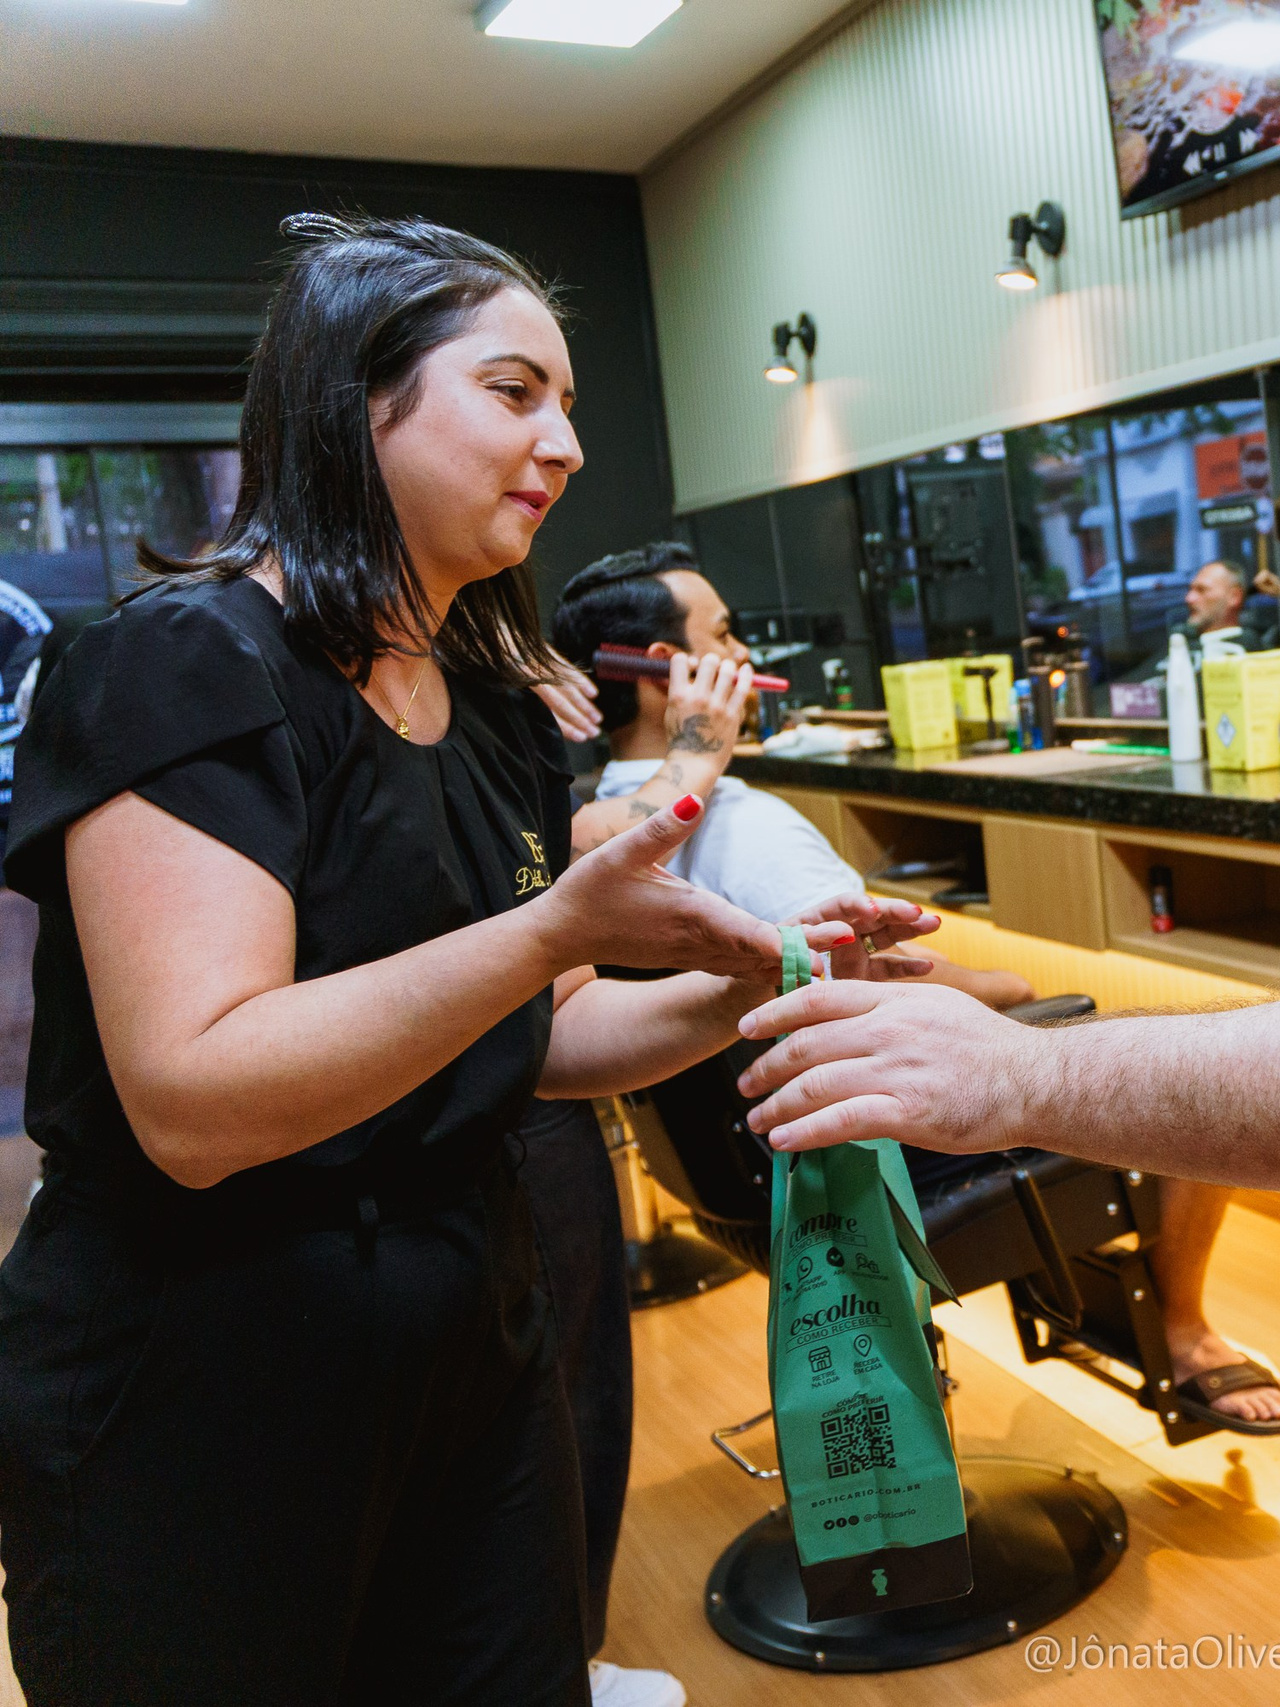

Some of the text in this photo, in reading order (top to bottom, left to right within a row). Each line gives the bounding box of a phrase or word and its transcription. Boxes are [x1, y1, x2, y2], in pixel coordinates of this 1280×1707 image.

[789, 1212, 858, 1249] compre
[790, 1293, 882, 1336] escolha
[797, 1316, 879, 1345] COMO RECEBER
[811, 1370, 837, 1382] RETIRE
[865, 1363, 883, 1373] CASA
[822, 1376, 840, 1386] LOJA
[821, 1396, 885, 1418] COMO PREFERIR
